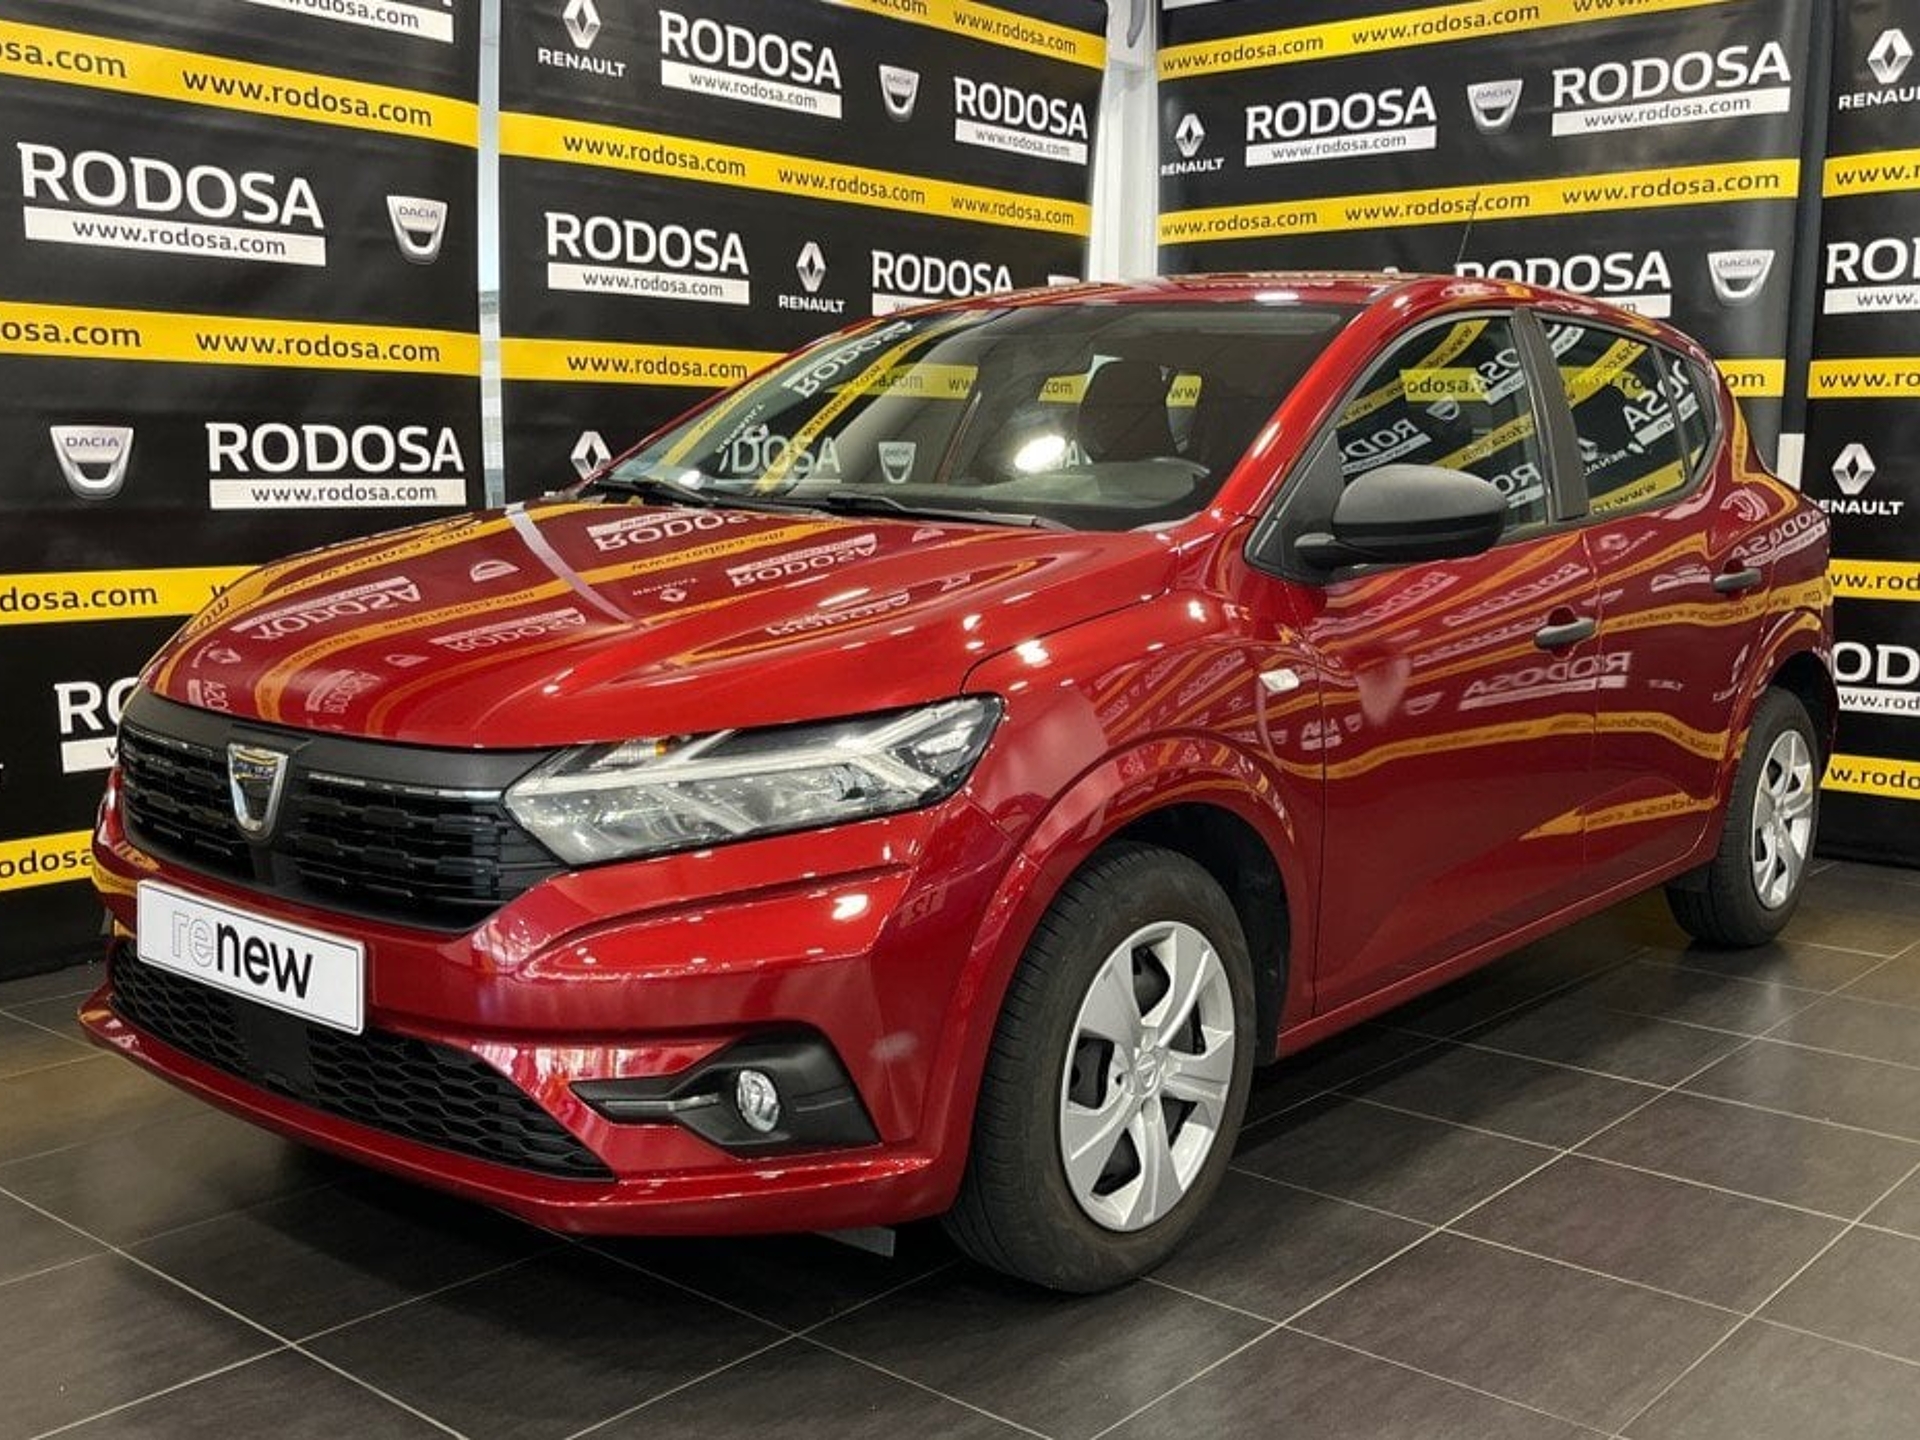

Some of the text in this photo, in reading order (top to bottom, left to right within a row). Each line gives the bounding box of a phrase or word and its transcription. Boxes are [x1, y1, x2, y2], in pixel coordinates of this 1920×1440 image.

[954, 11, 1076, 54] www.rodosa.com
[1352, 4, 1540, 46] www.rodosa.com
[0, 42, 127, 78] sa.com
[538, 48, 626, 77] RENAULT
[659, 9, 842, 89] RODOSA
[1162, 36, 1324, 72] www.rodosa.com
[1552, 41, 1791, 108] RODOSA
[183, 69, 432, 127] www.rodosa.com
[689, 72, 817, 109] www.rodosa.com
[1475, 87, 1513, 99] DACIA
[954, 76, 1088, 139] RODOSA
[1246, 85, 1436, 141] RODOSA
[1585, 98, 1752, 129] www.rodosa.com
[563, 136, 746, 176] www.rodosa.com
[976, 128, 1070, 156] www.rodosa.com
[1271, 133, 1407, 160] www.rodosa.com
[1161, 157, 1224, 176] RENAULT
[17, 142, 324, 229] RODOSA
[778, 168, 925, 204] www.rodosa.com
[1562, 173, 1780, 205] www.rodosa.com
[399, 206, 437, 219] DACIA
[950, 195, 1074, 226] www.rodosa.com
[1345, 192, 1531, 222] www.rodosa.com
[73, 218, 286, 256] www.rodosa.com
[1161, 211, 1318, 237] www.rodosa.com
[545, 211, 749, 274] RODOSA
[872, 250, 1013, 297] RODOSA
[1718, 257, 1762, 268] DACIA
[583, 272, 723, 297] www.rodosa.com
[779, 296, 845, 313] RENAULT
[196, 332, 440, 362] www.rodosa.com
[567, 352, 748, 379] www.rodosa.com
[65, 436, 119, 448] DACIA
[205, 422, 465, 472] RODOSA
[251, 483, 437, 502] www.rodosa.com
[1819, 499, 1904, 516] ENAULT
[0, 586, 157, 612] dosa.com
[172, 909, 313, 999] renew
